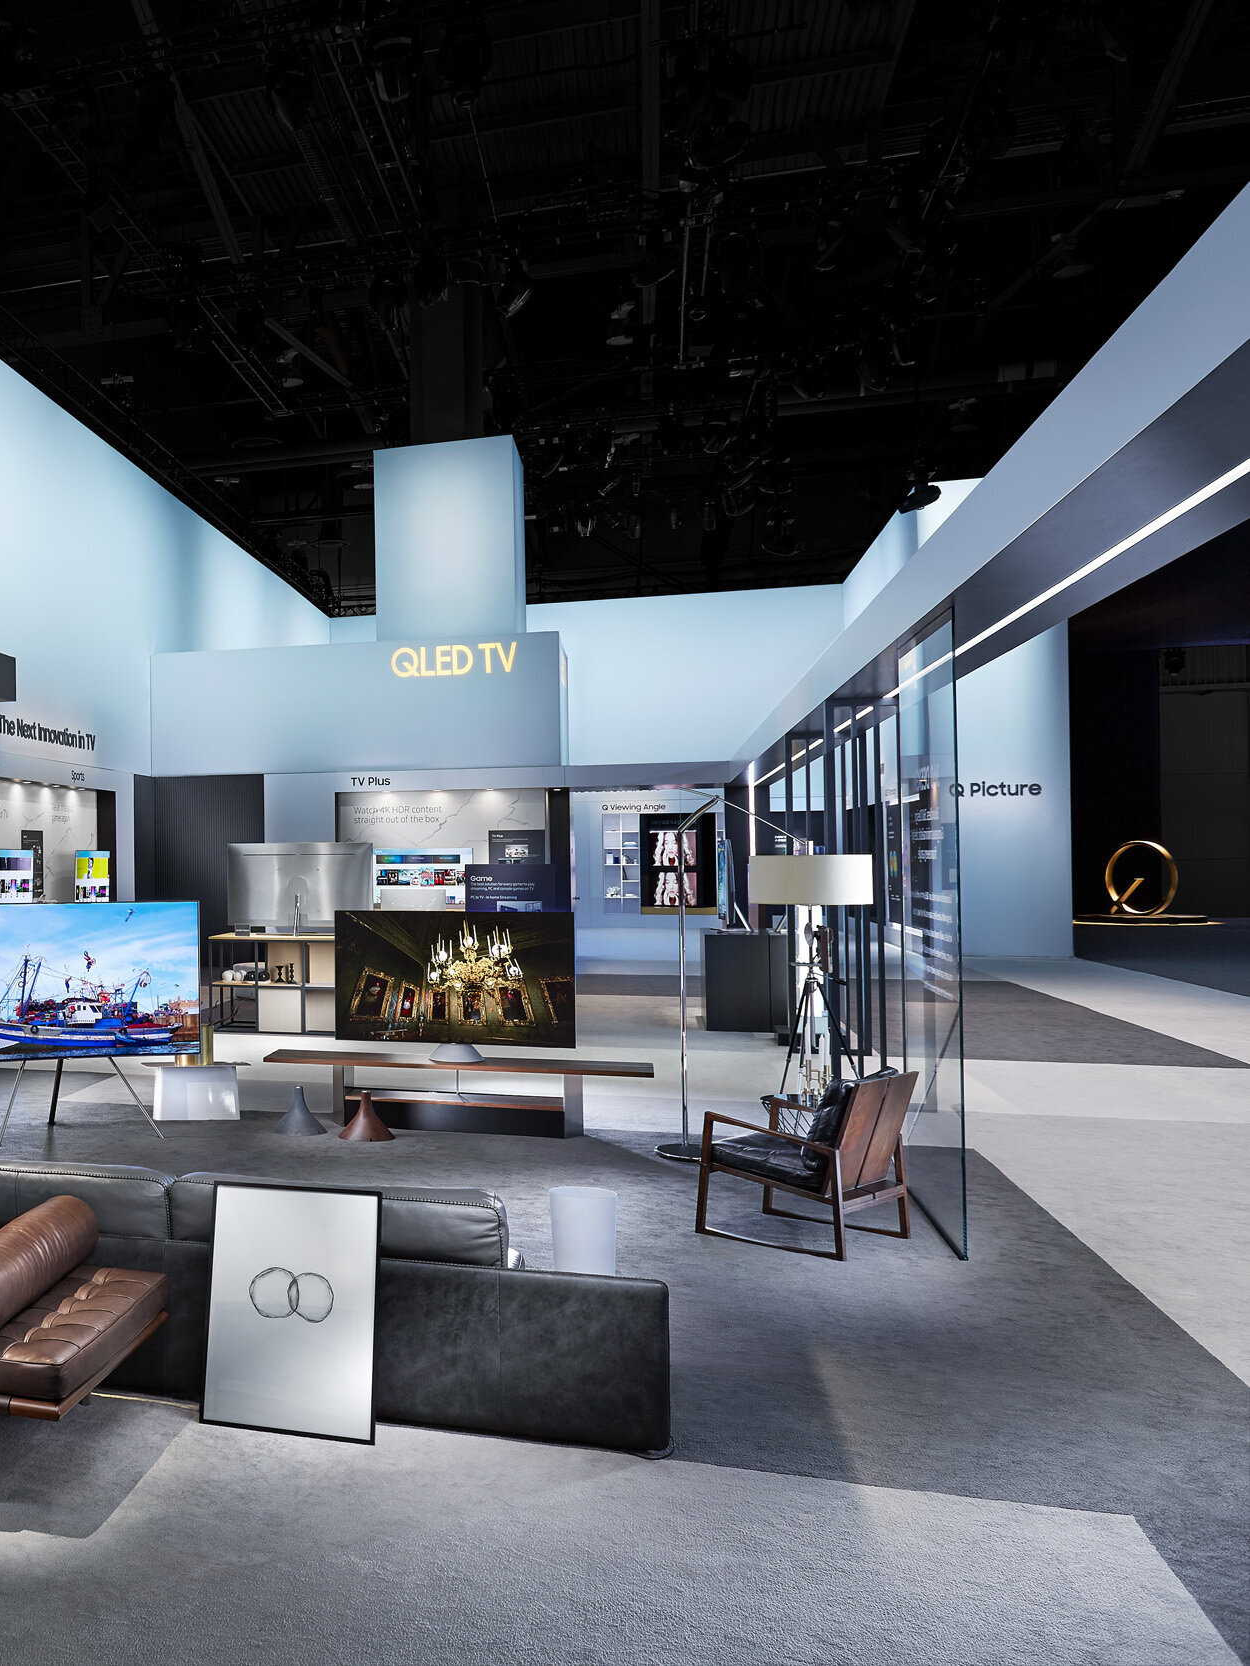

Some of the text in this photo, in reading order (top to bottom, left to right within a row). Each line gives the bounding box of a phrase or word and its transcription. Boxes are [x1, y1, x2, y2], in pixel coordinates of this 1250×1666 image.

[391, 641, 517, 678] QLED TV
[16, 718, 37, 741] Next
[37, 723, 78, 748] Innovation
[78, 730, 85, 750] in
[85, 733, 96, 751] TV
[71, 770, 85, 784] Sports
[351, 776, 391, 787] TV Plus
[949, 780, 1042, 797] Q Picture
[353, 805, 442, 815] Watch 4K HDR content
[610, 803, 642, 812] Viewing
[643, 803, 666, 812] Angle
[353, 815, 440, 825] straight out of the box
